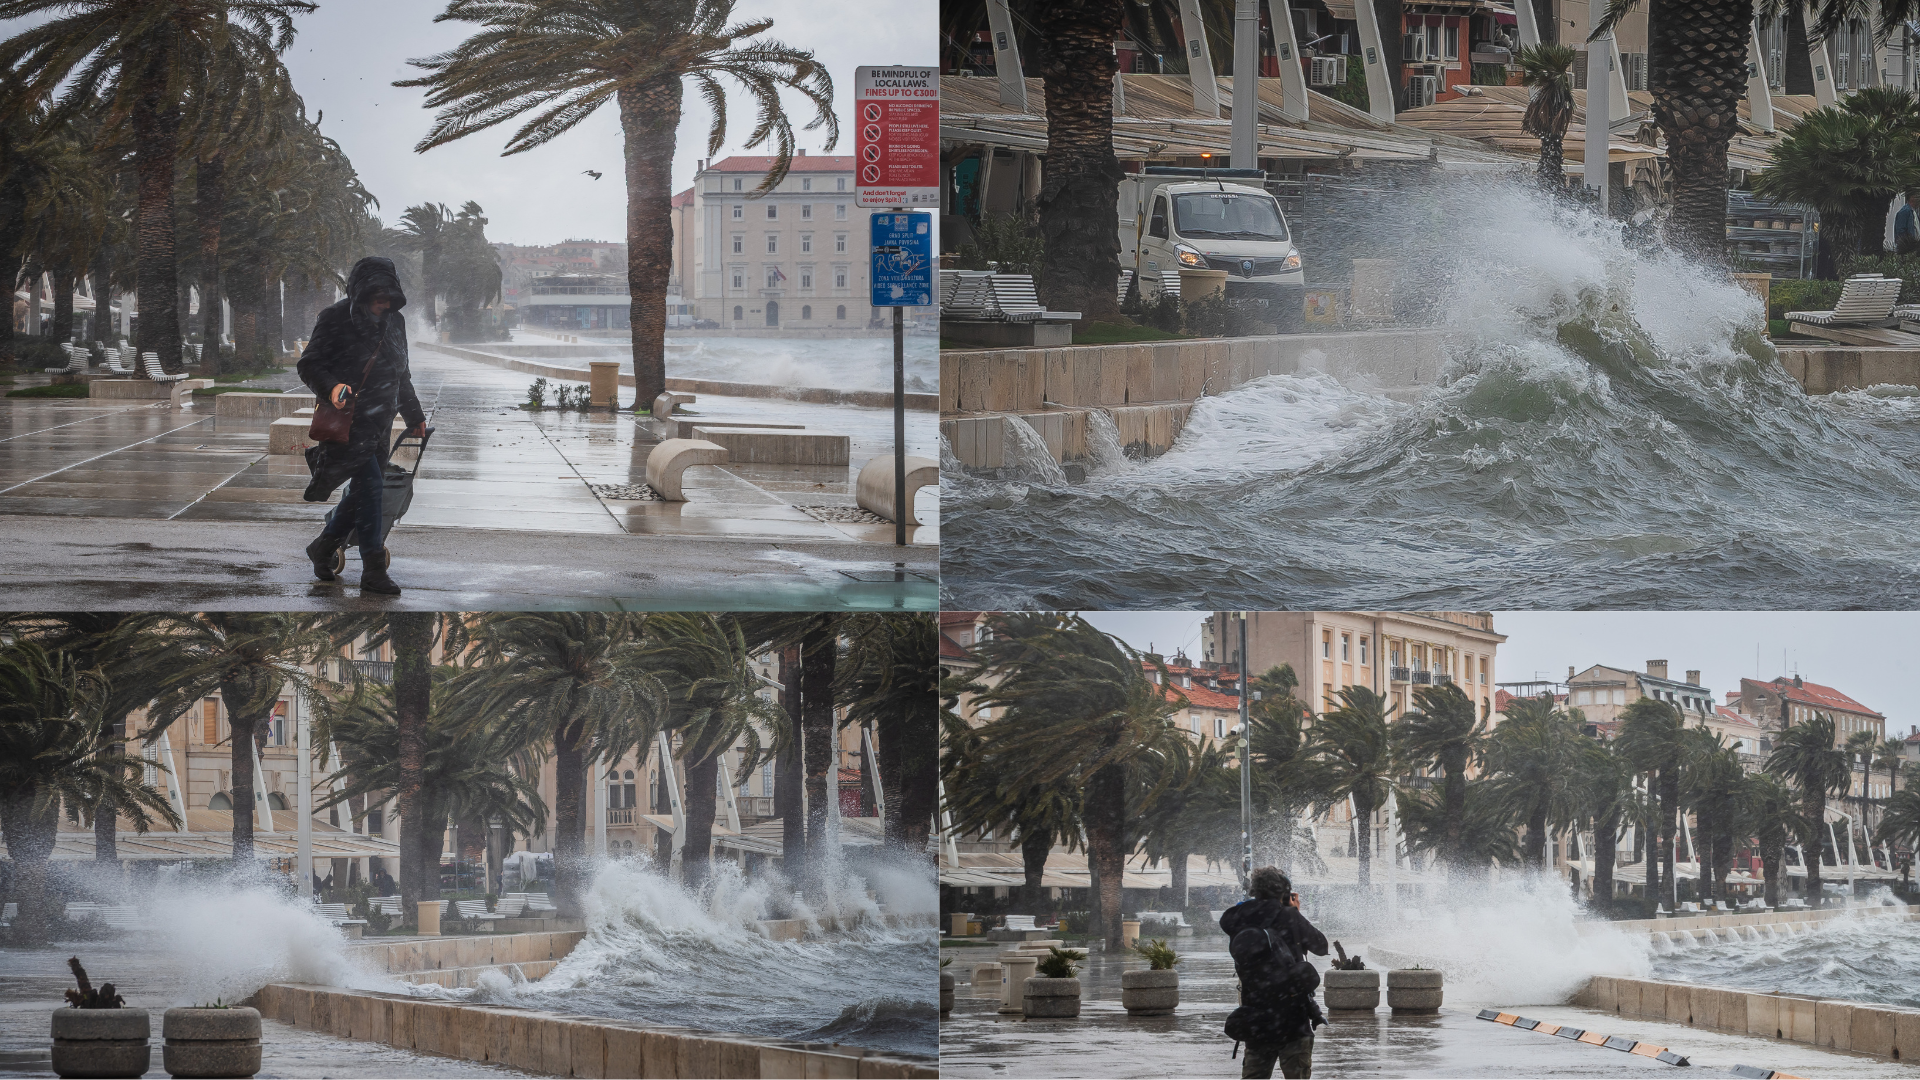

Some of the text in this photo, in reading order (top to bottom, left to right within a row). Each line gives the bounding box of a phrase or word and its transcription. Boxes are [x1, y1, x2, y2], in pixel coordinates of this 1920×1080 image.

[872, 70, 931, 78] BE MINDFUL OF
[866, 89, 937, 97] FINES UP TO €300!
